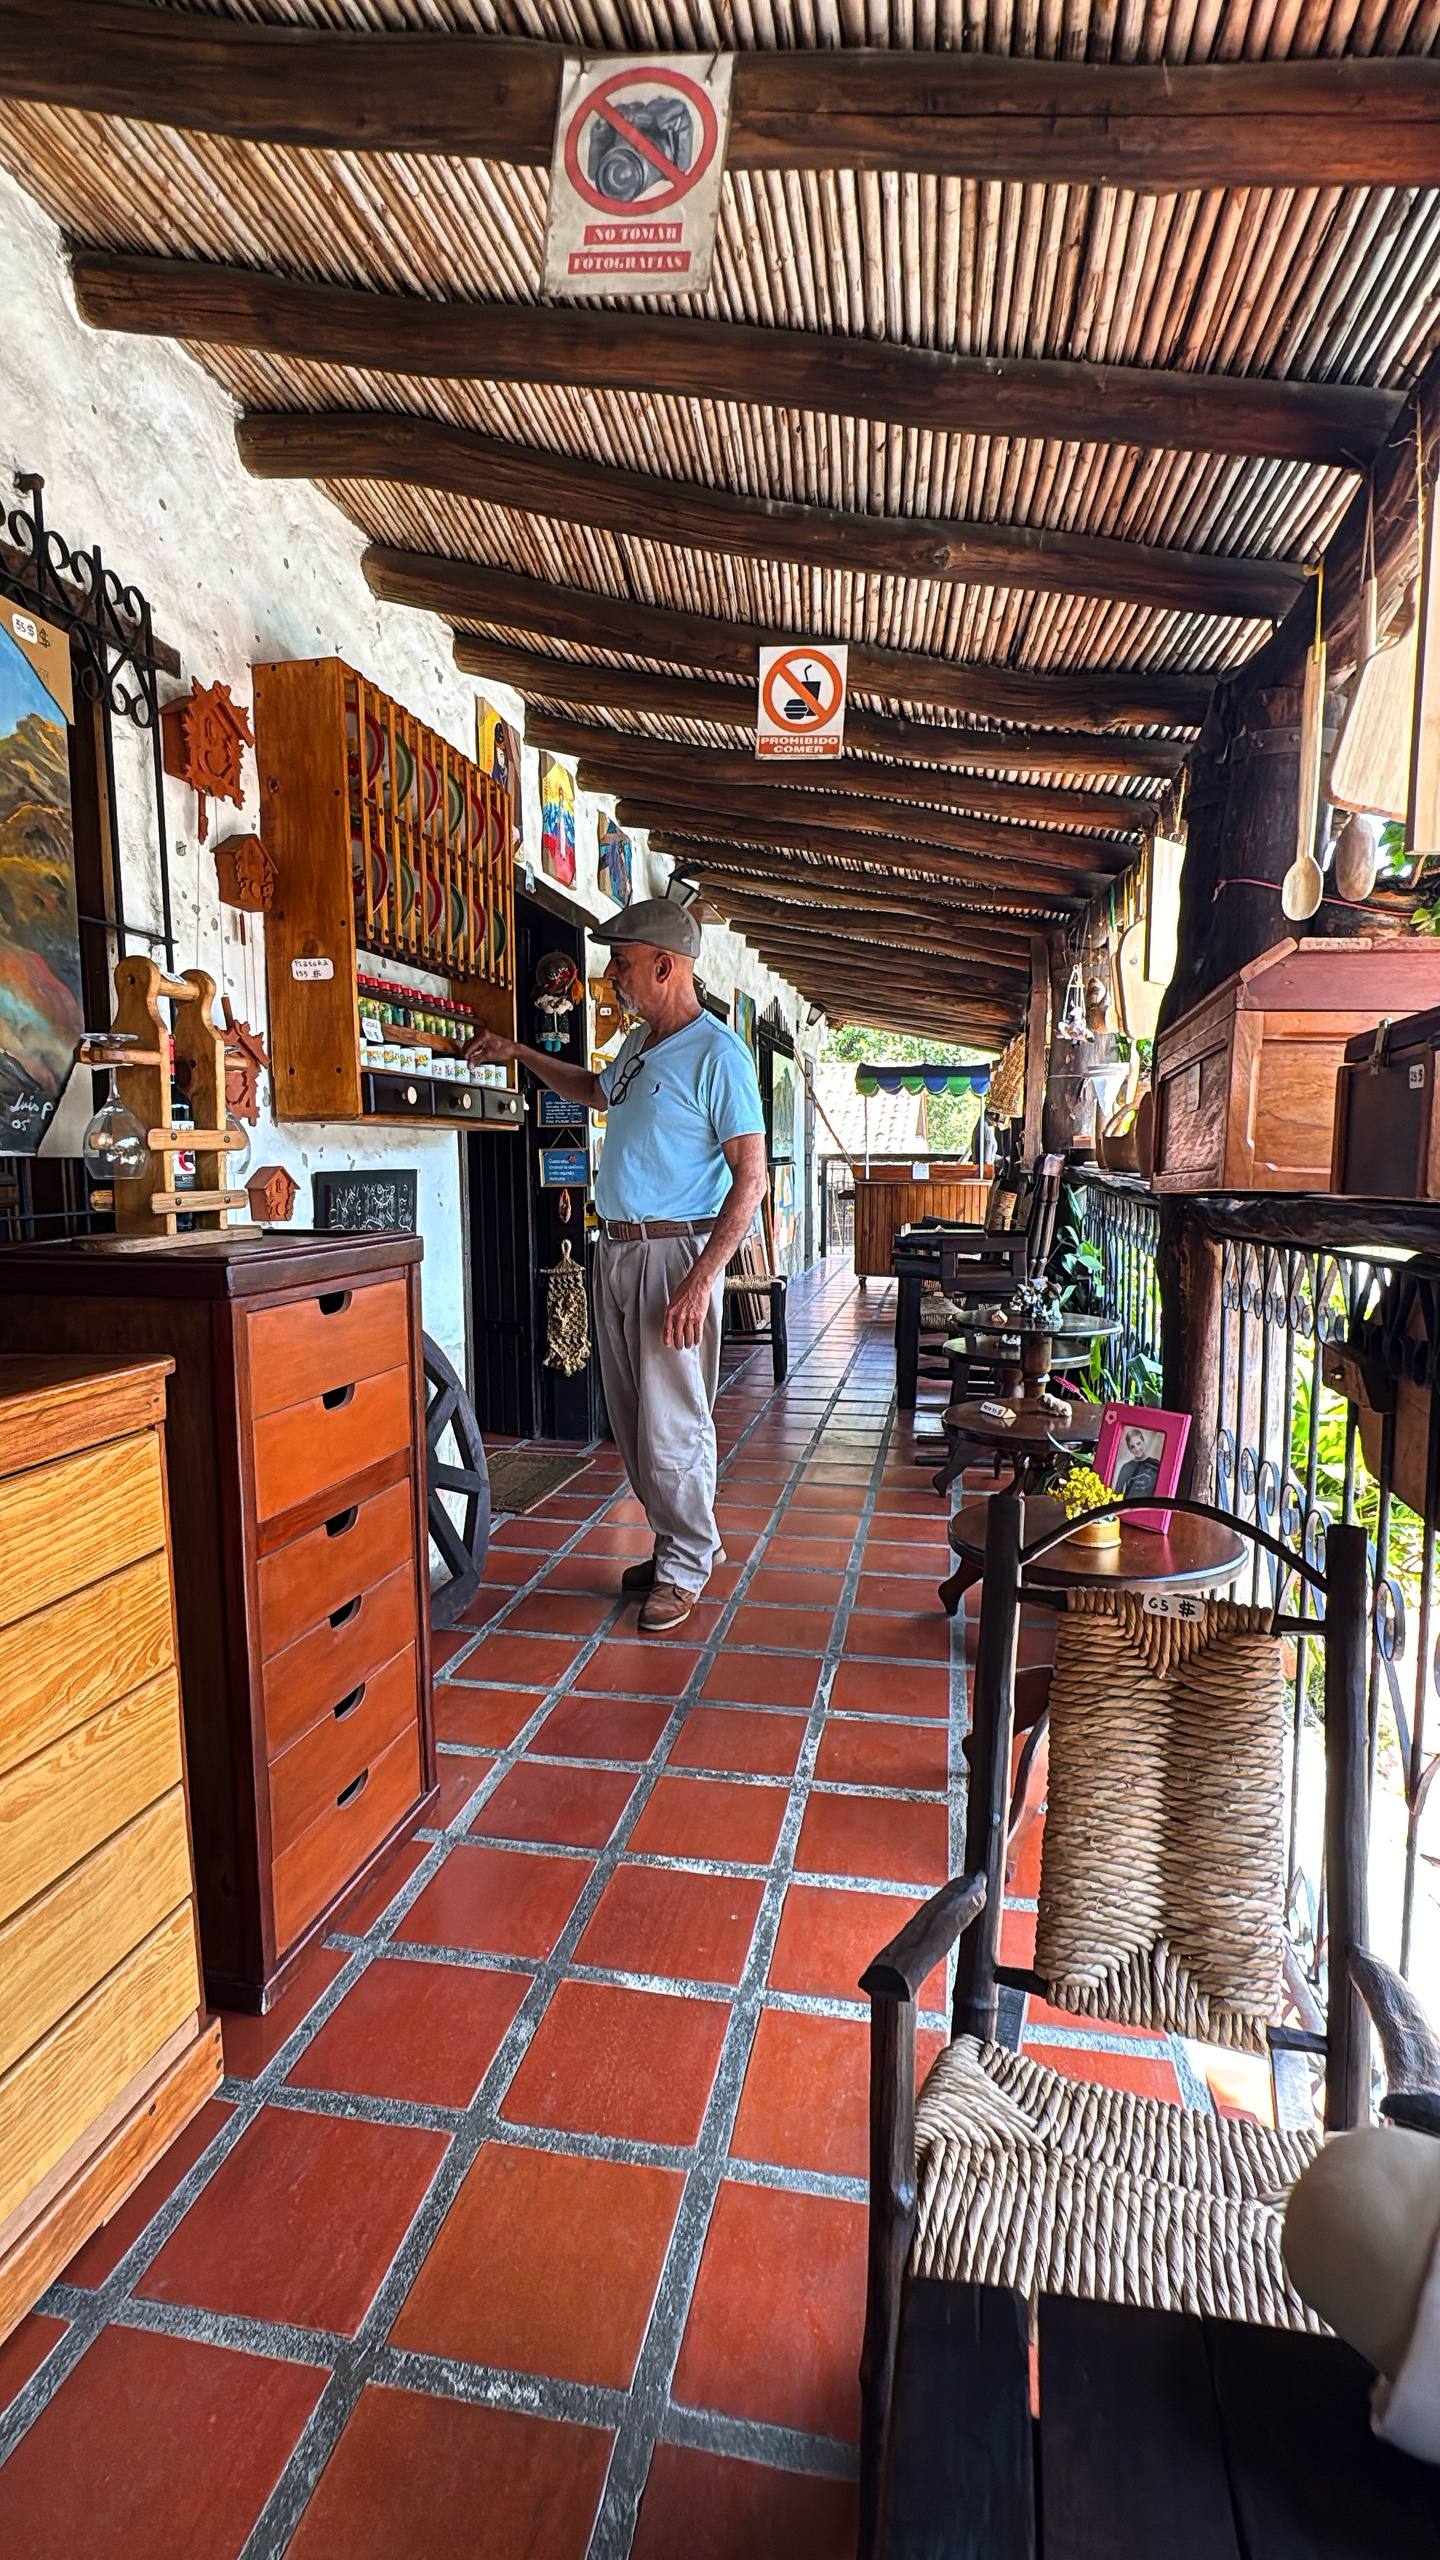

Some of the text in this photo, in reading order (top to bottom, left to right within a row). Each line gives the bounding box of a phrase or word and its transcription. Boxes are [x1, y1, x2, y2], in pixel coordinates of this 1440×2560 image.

[593, 226, 678, 241] NO TOMAR
[572, 254, 683, 270] FOTOGRAFIAS
[761, 736, 839, 745] PROHIBIDO
[773, 745, 824, 754] COMER
